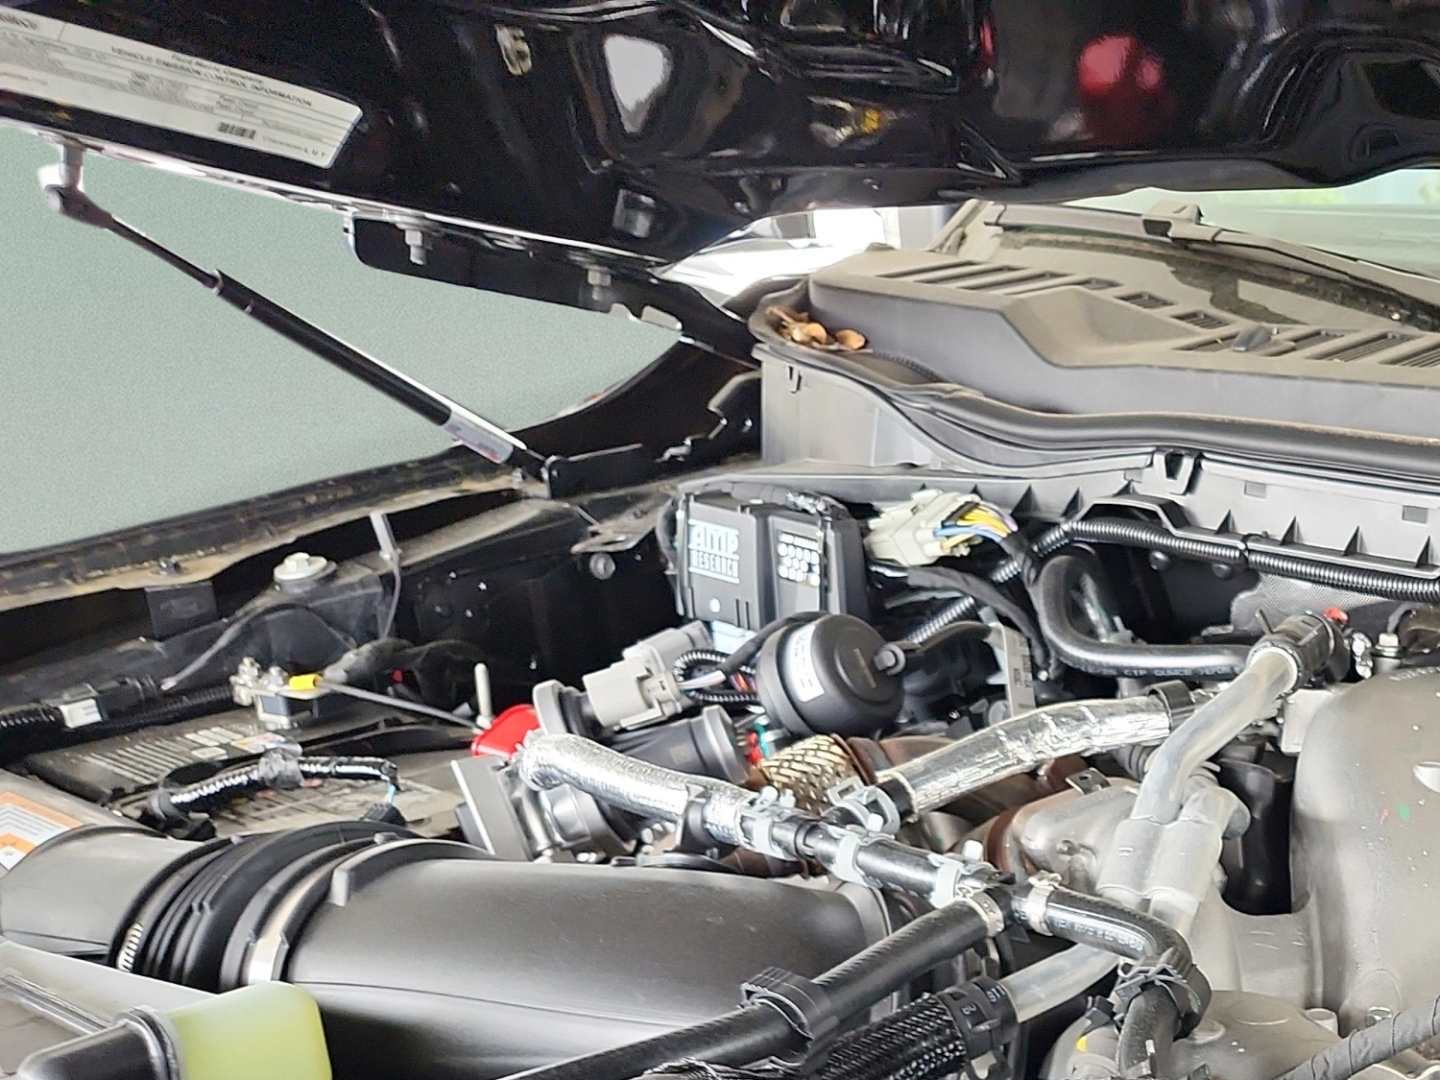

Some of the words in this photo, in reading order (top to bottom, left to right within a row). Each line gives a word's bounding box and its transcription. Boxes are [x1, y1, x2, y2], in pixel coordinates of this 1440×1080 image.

[111, 46, 153, 61] VEHICLE
[155, 58, 201, 76] EMISSION
[203, 70, 247, 88] CONTROL
[250, 84, 312, 107] INFORMATION
[689, 524, 739, 554] AMP
[690, 550, 739, 579] RESEARCH
